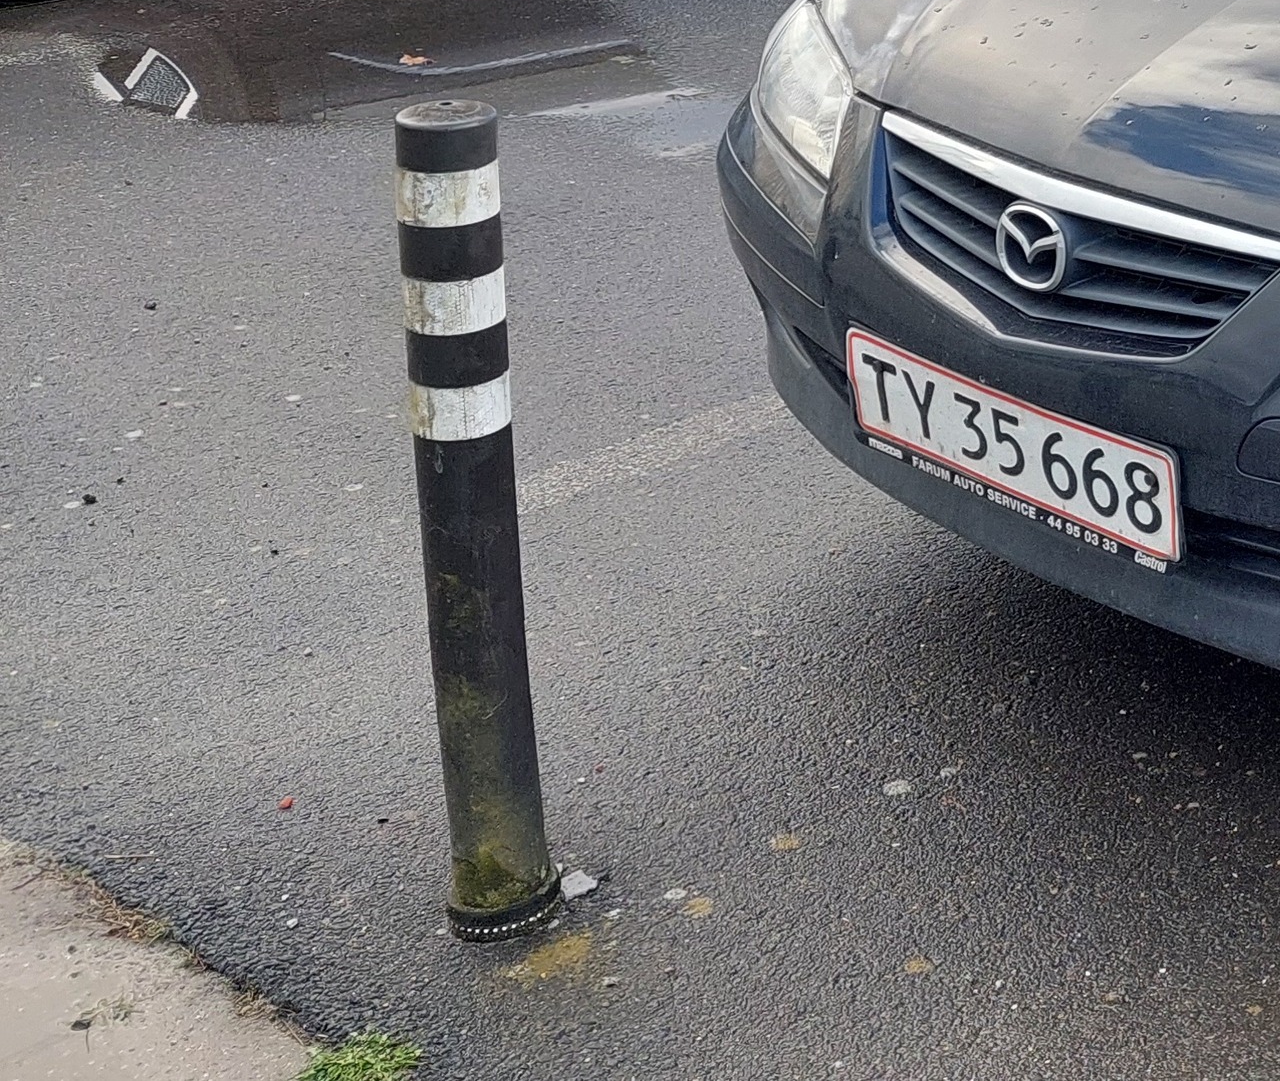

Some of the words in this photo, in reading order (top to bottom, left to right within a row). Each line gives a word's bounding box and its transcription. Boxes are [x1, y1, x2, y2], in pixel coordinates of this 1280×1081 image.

[861, 352, 936, 440] TY
[953, 392, 1025, 477] 35
[1041, 431, 1163, 535] 668
[911, 455, 950, 482] FARUM
[953, 474, 984, 496] AUTO
[987, 489, 1036, 519] SERVICE
[1046, 515, 1062, 531] 44
[1065, 522, 1081, 538] 95
[1084, 530, 1099, 546] 03
[1102, 538, 1118, 554] 33
[1134, 550, 1167, 574] Castrol
